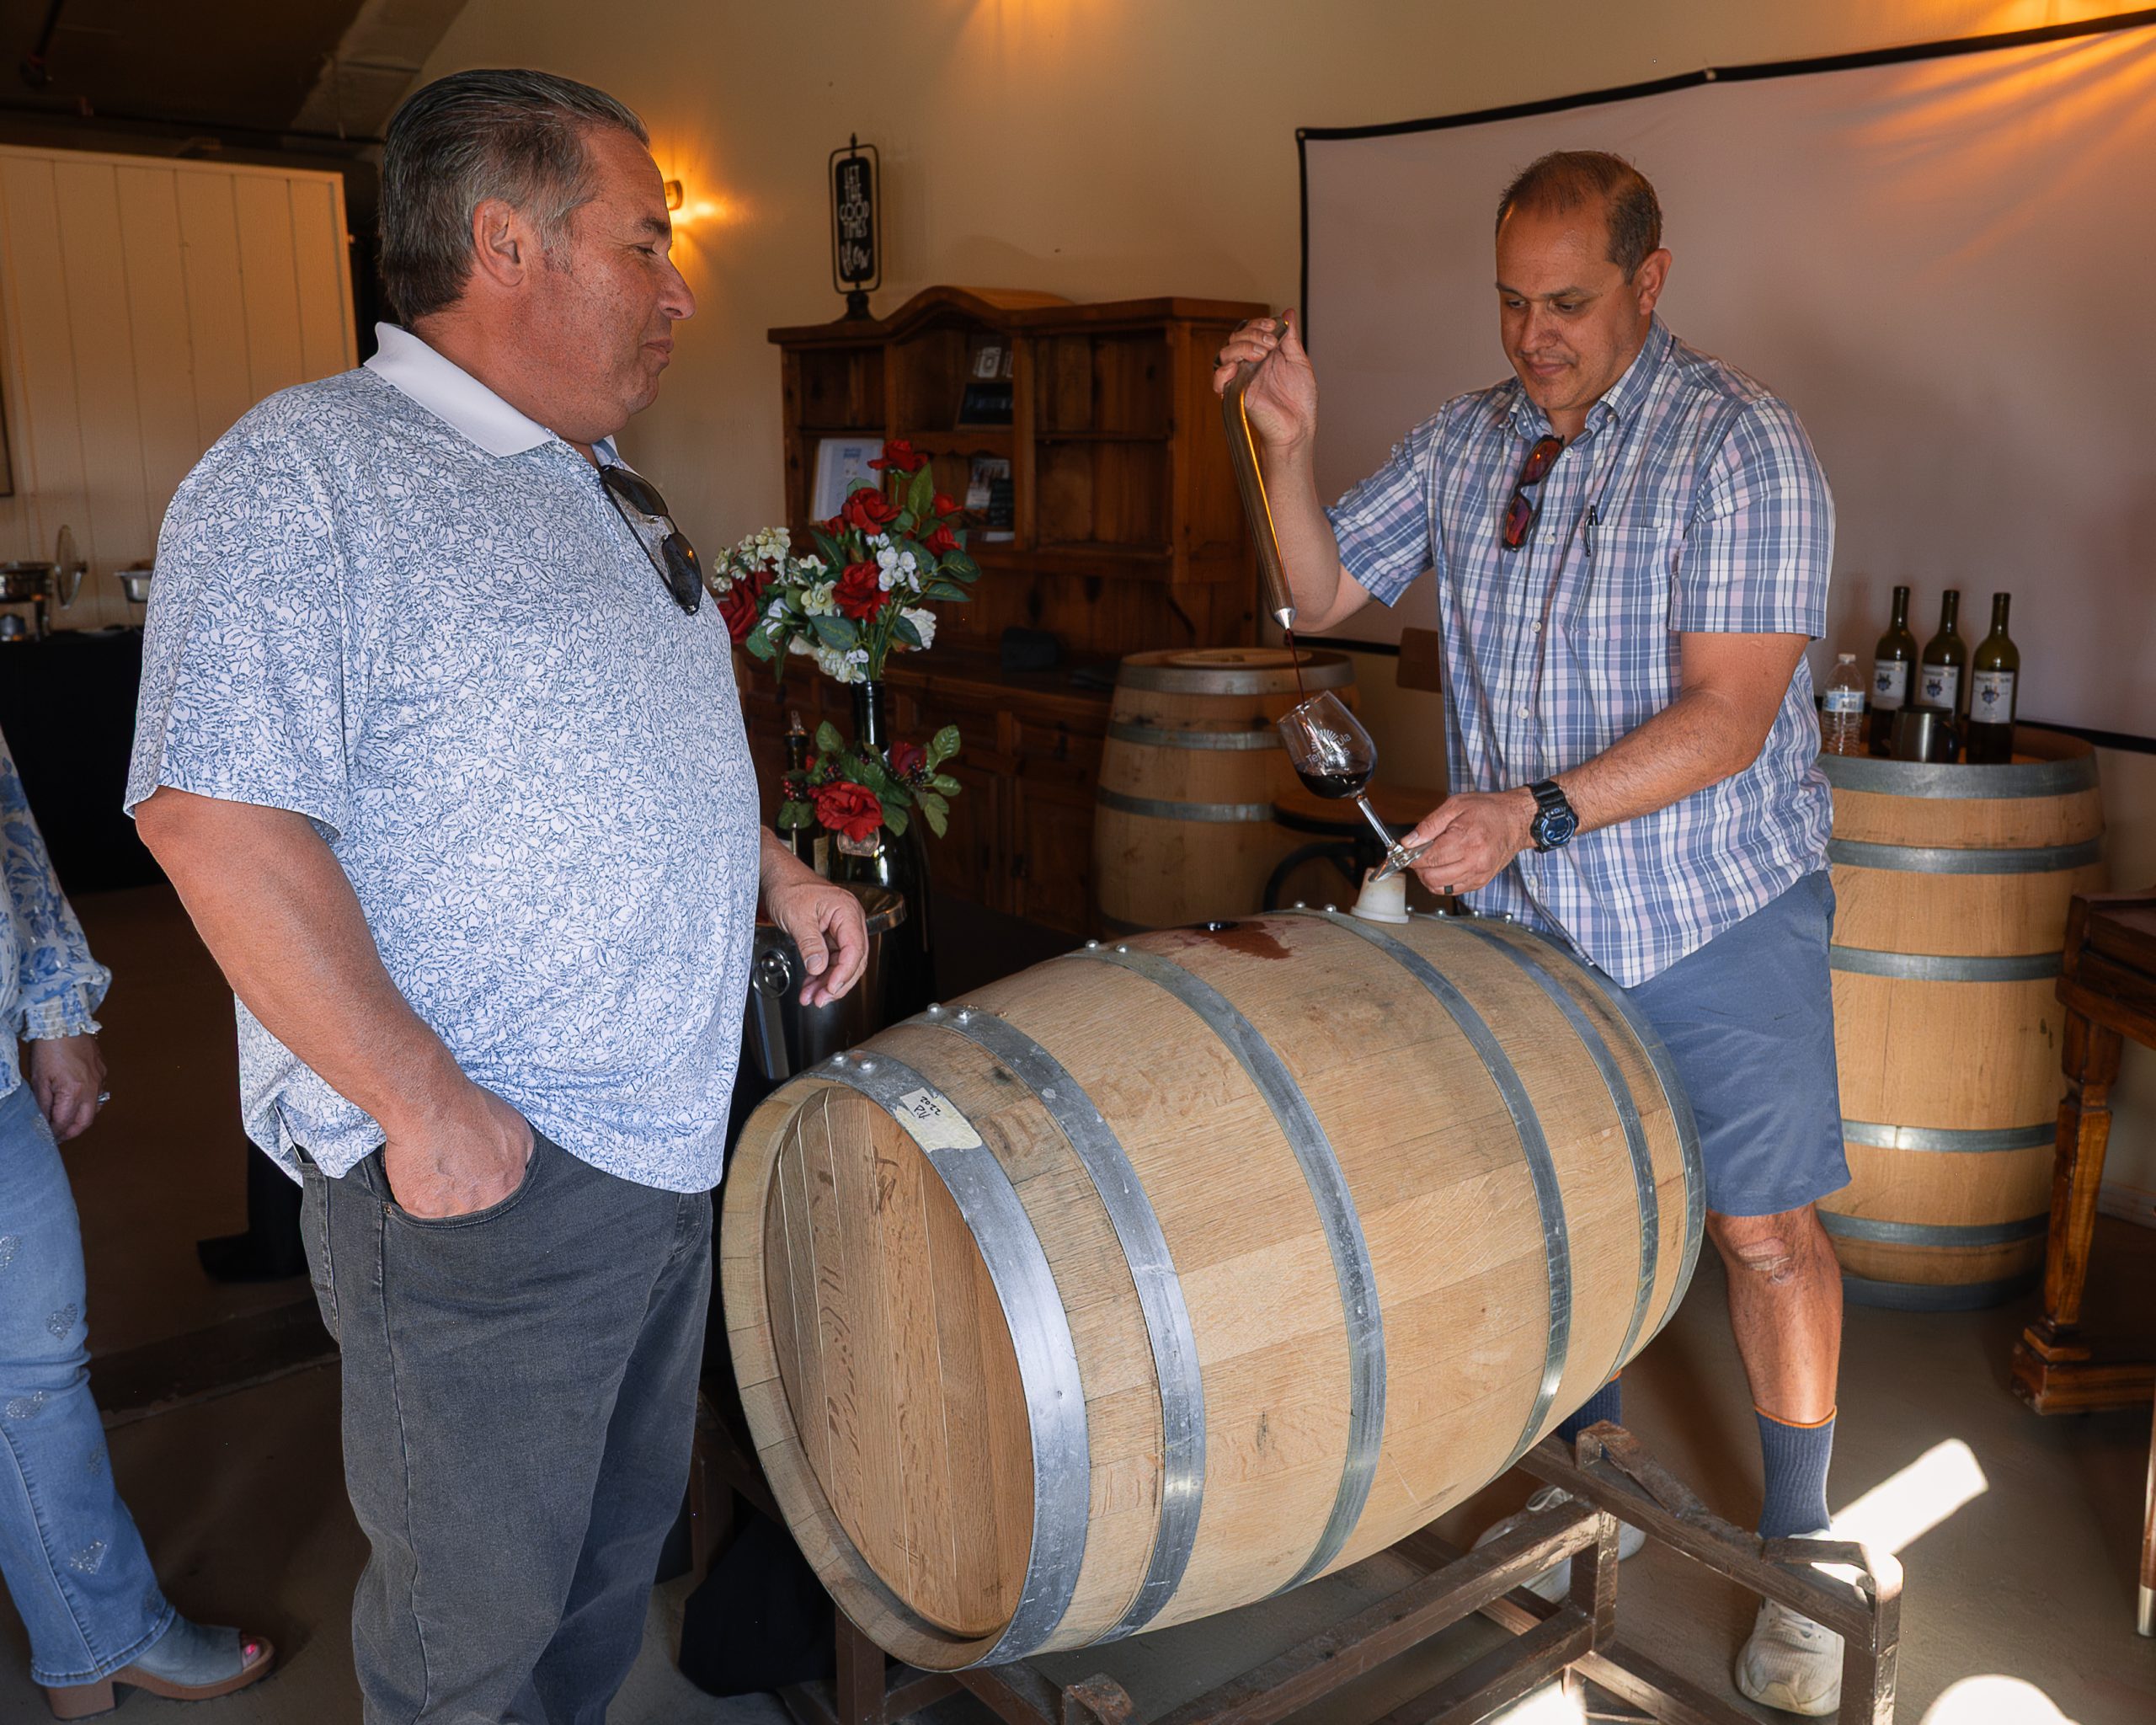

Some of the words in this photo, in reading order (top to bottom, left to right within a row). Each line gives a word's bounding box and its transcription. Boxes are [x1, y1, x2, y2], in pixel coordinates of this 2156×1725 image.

[843, 165, 860, 184] LET
[844, 184, 862, 202] THE
[839, 200, 870, 221] GOOD
[842, 219, 867, 239] TIMES
[1305, 733, 1352, 767] Temeula
[920, 1096, 942, 1116] 2022
